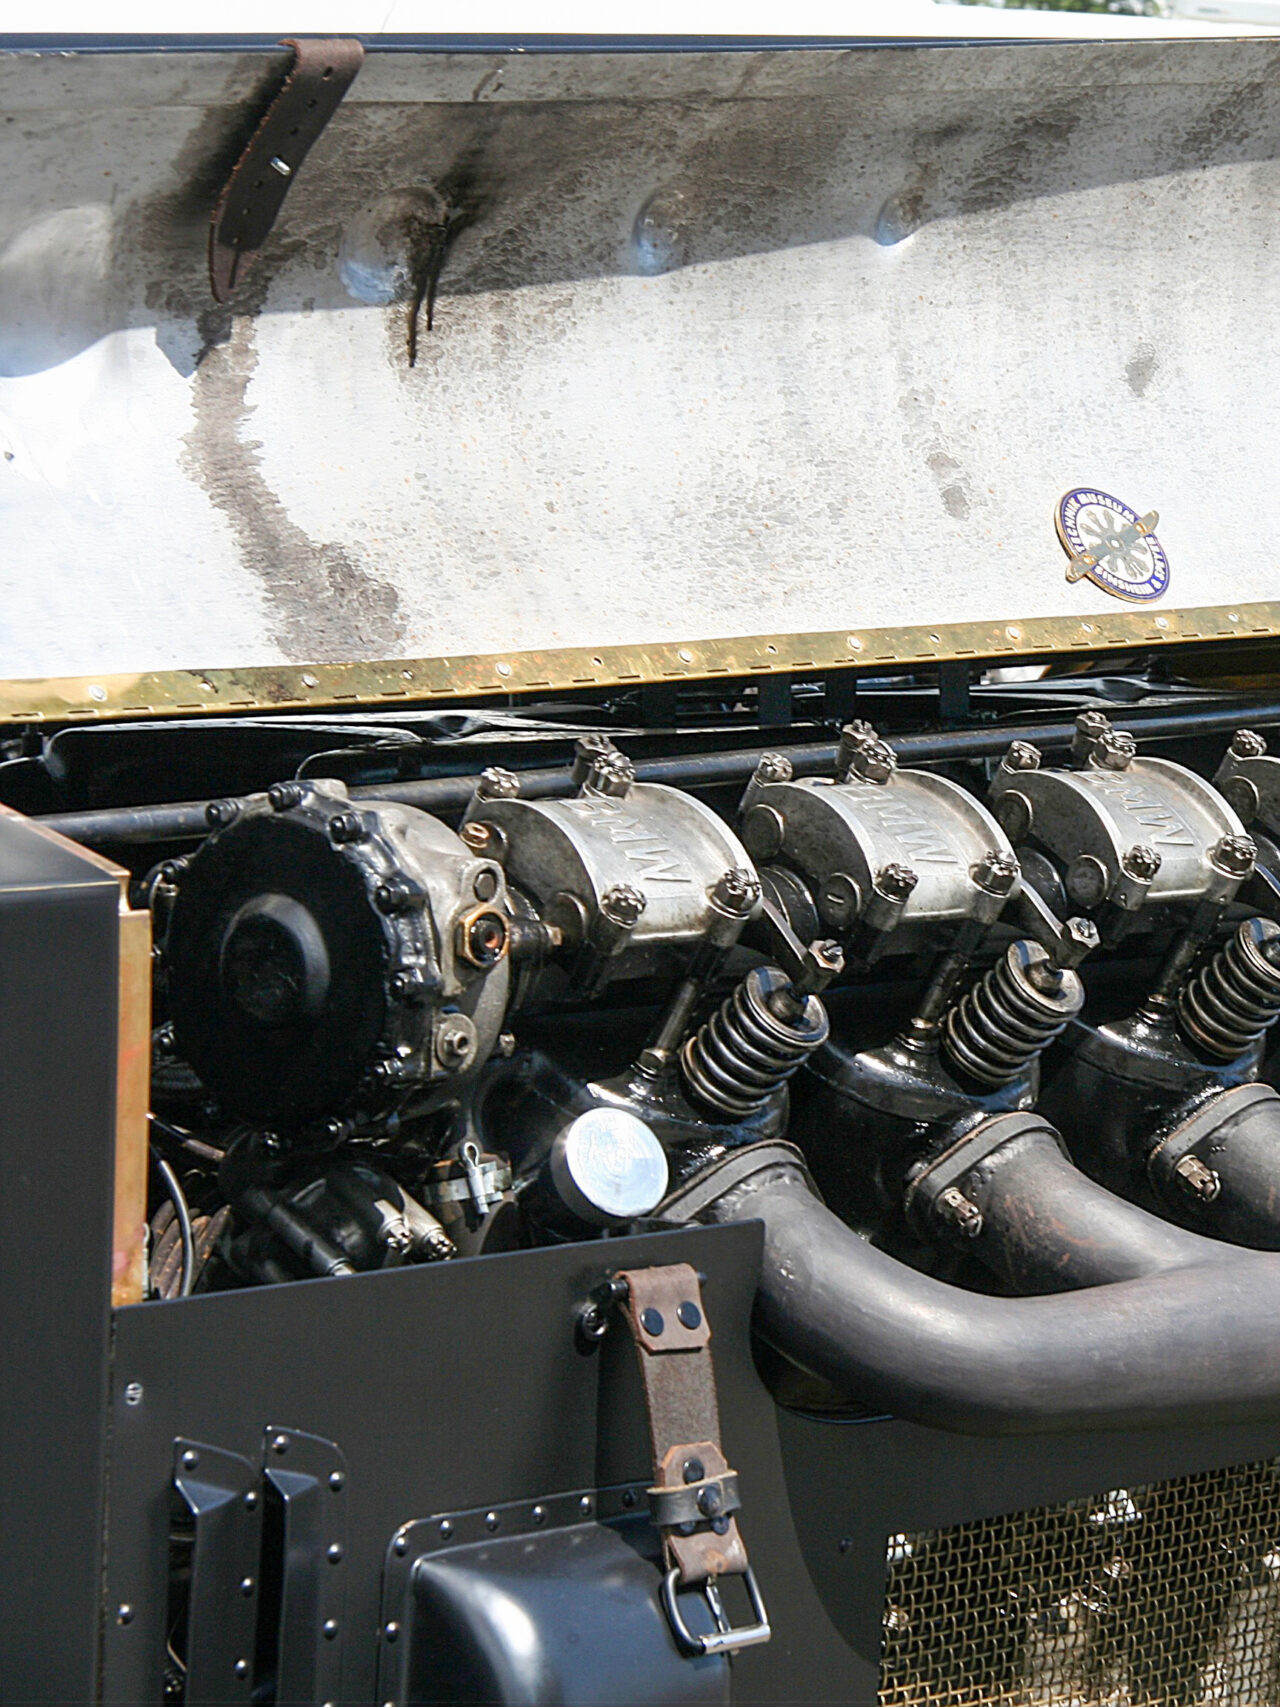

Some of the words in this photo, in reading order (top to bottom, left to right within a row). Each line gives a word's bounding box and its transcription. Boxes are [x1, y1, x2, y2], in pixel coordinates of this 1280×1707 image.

[1077, 493, 1135, 525] MUSEUM
[558, 799, 692, 883] BMW
[830, 785, 959, 864] BMW
[1073, 771, 1194, 846] BMW
